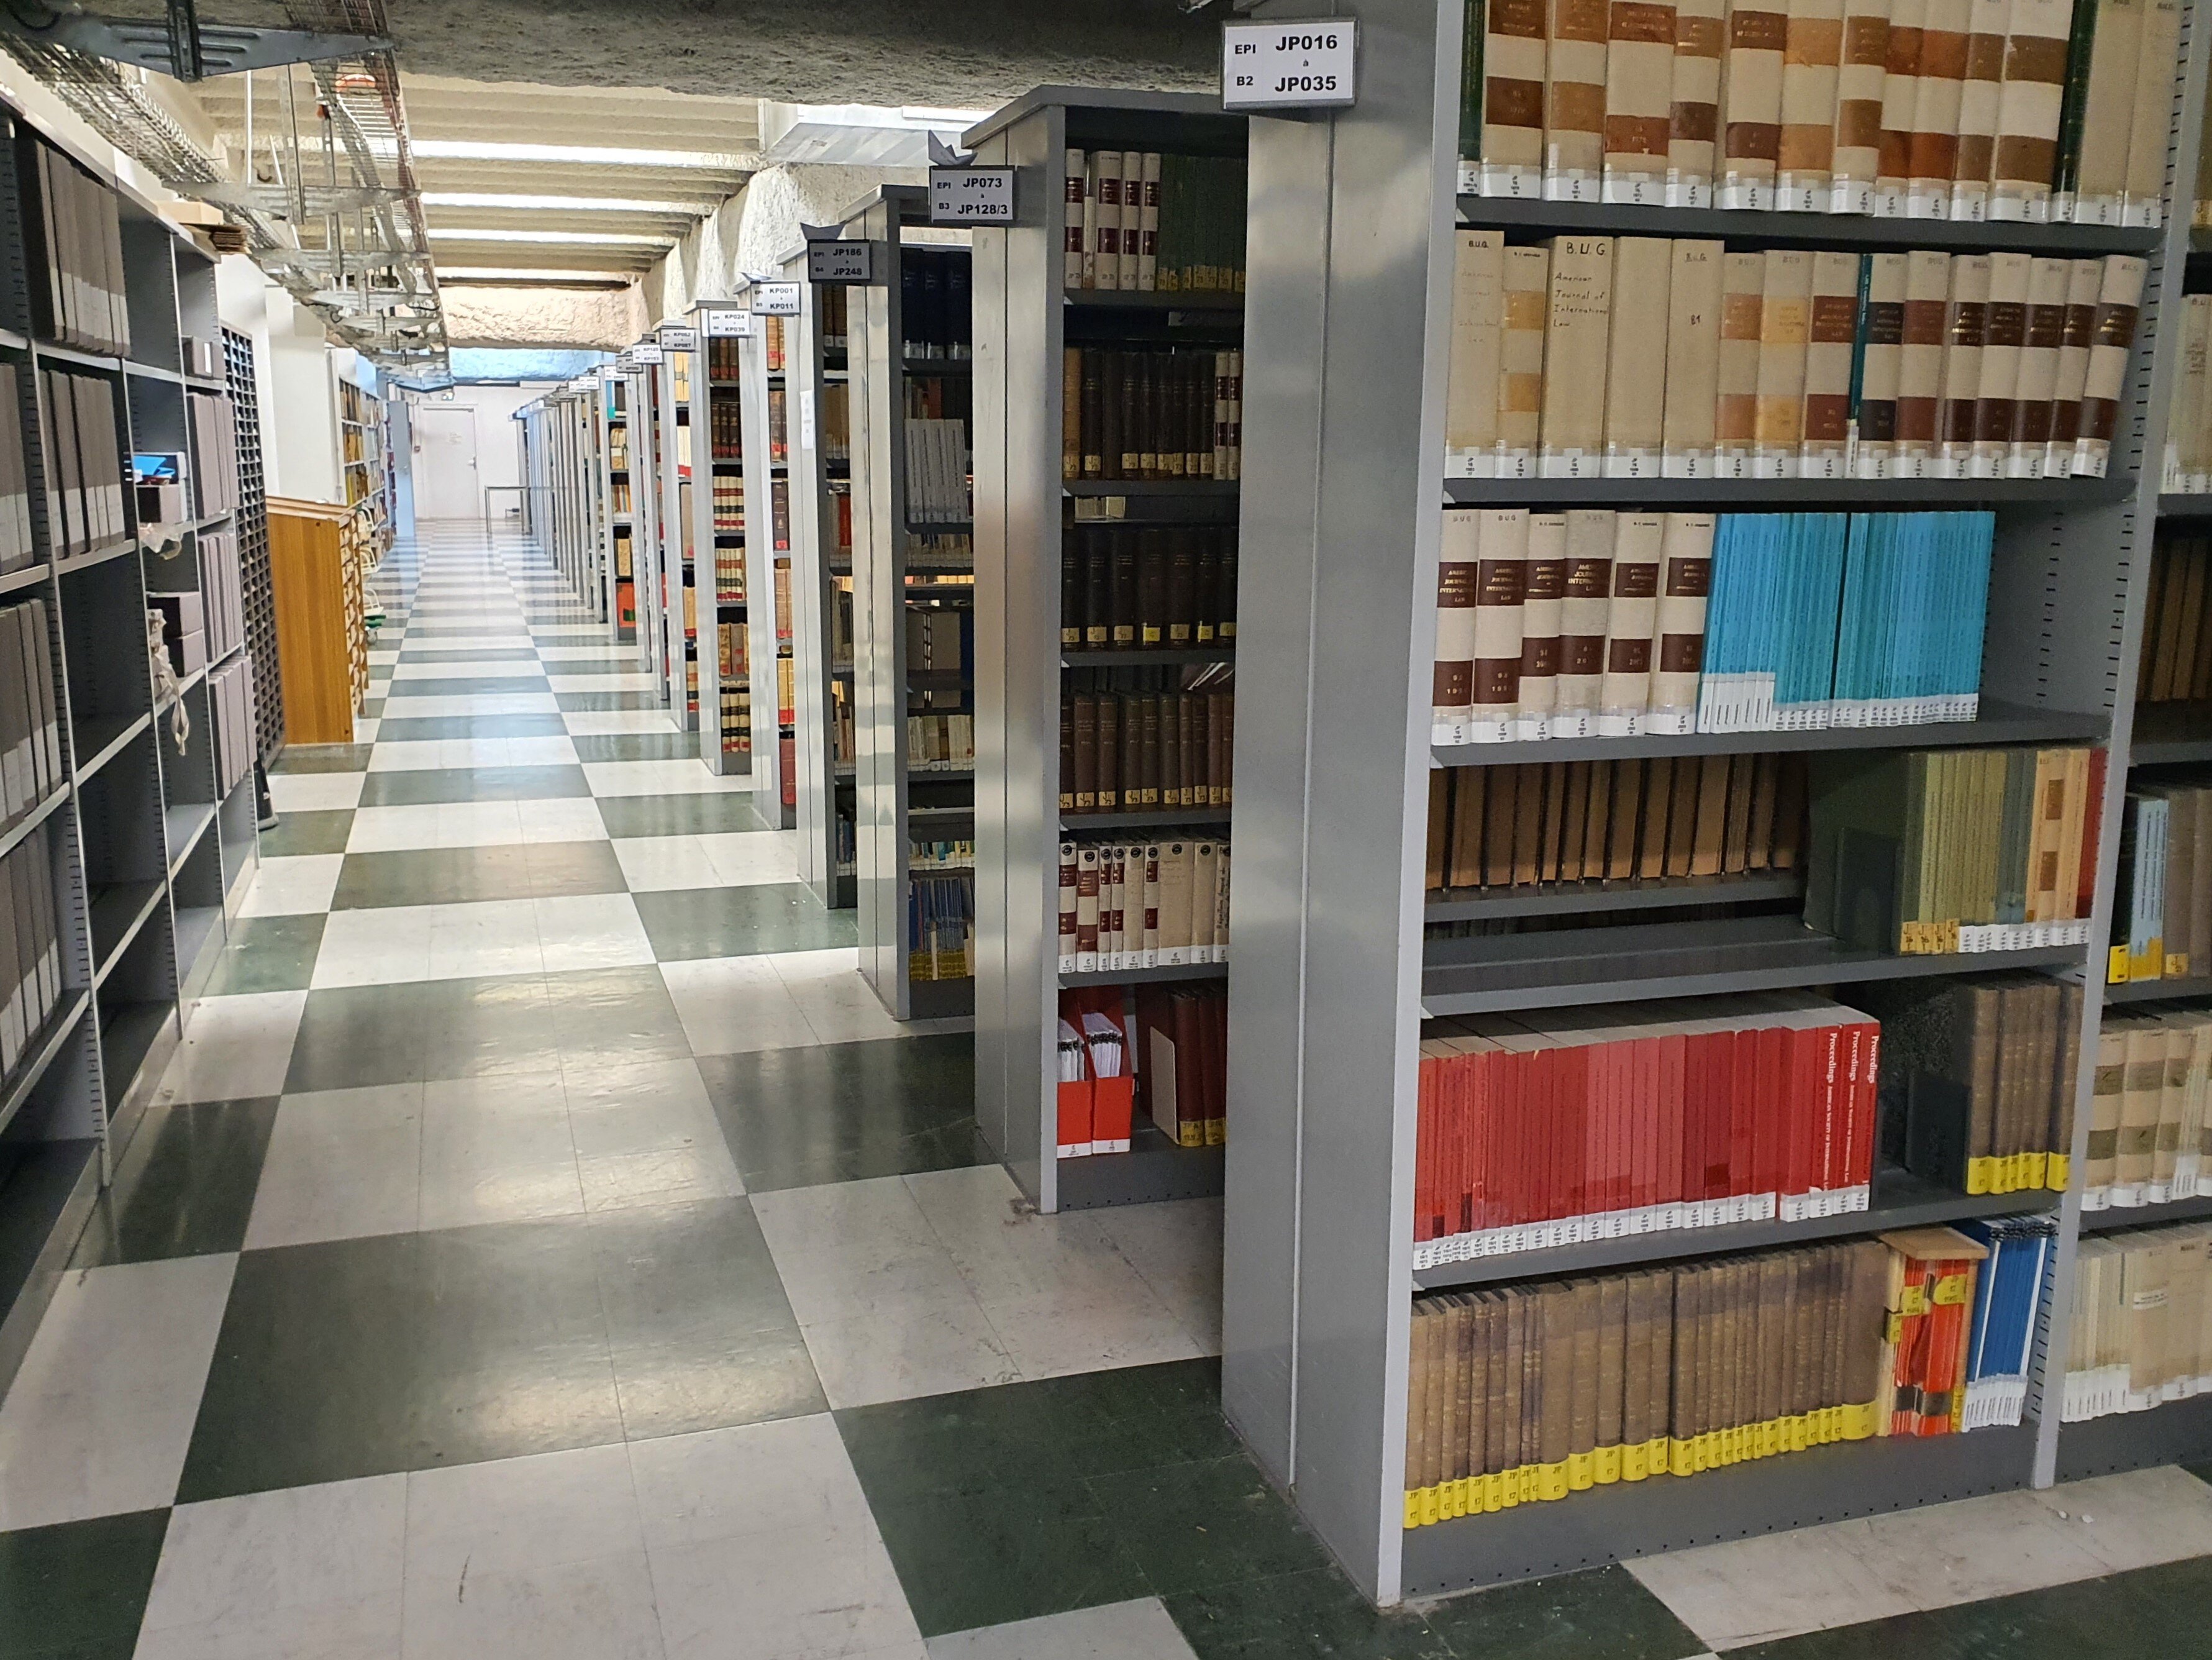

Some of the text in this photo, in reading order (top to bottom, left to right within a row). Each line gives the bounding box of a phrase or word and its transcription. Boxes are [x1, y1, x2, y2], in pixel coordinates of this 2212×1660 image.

[1235, 35, 1338, 54] EPI JP016
[1236, 76, 1337, 92] B2 JP035
[963, 178, 1002, 188] JP073
[957, 204, 1008, 214] JP128/3
[1555, 272, 1591, 281] American
[1555, 290, 1604, 299] Journal of
[1826, 1033, 1837, 1084] Proceedings
[1849, 1031, 1861, 1081] Proceedings
[1867, 1036, 1880, 1083] Proceedings
